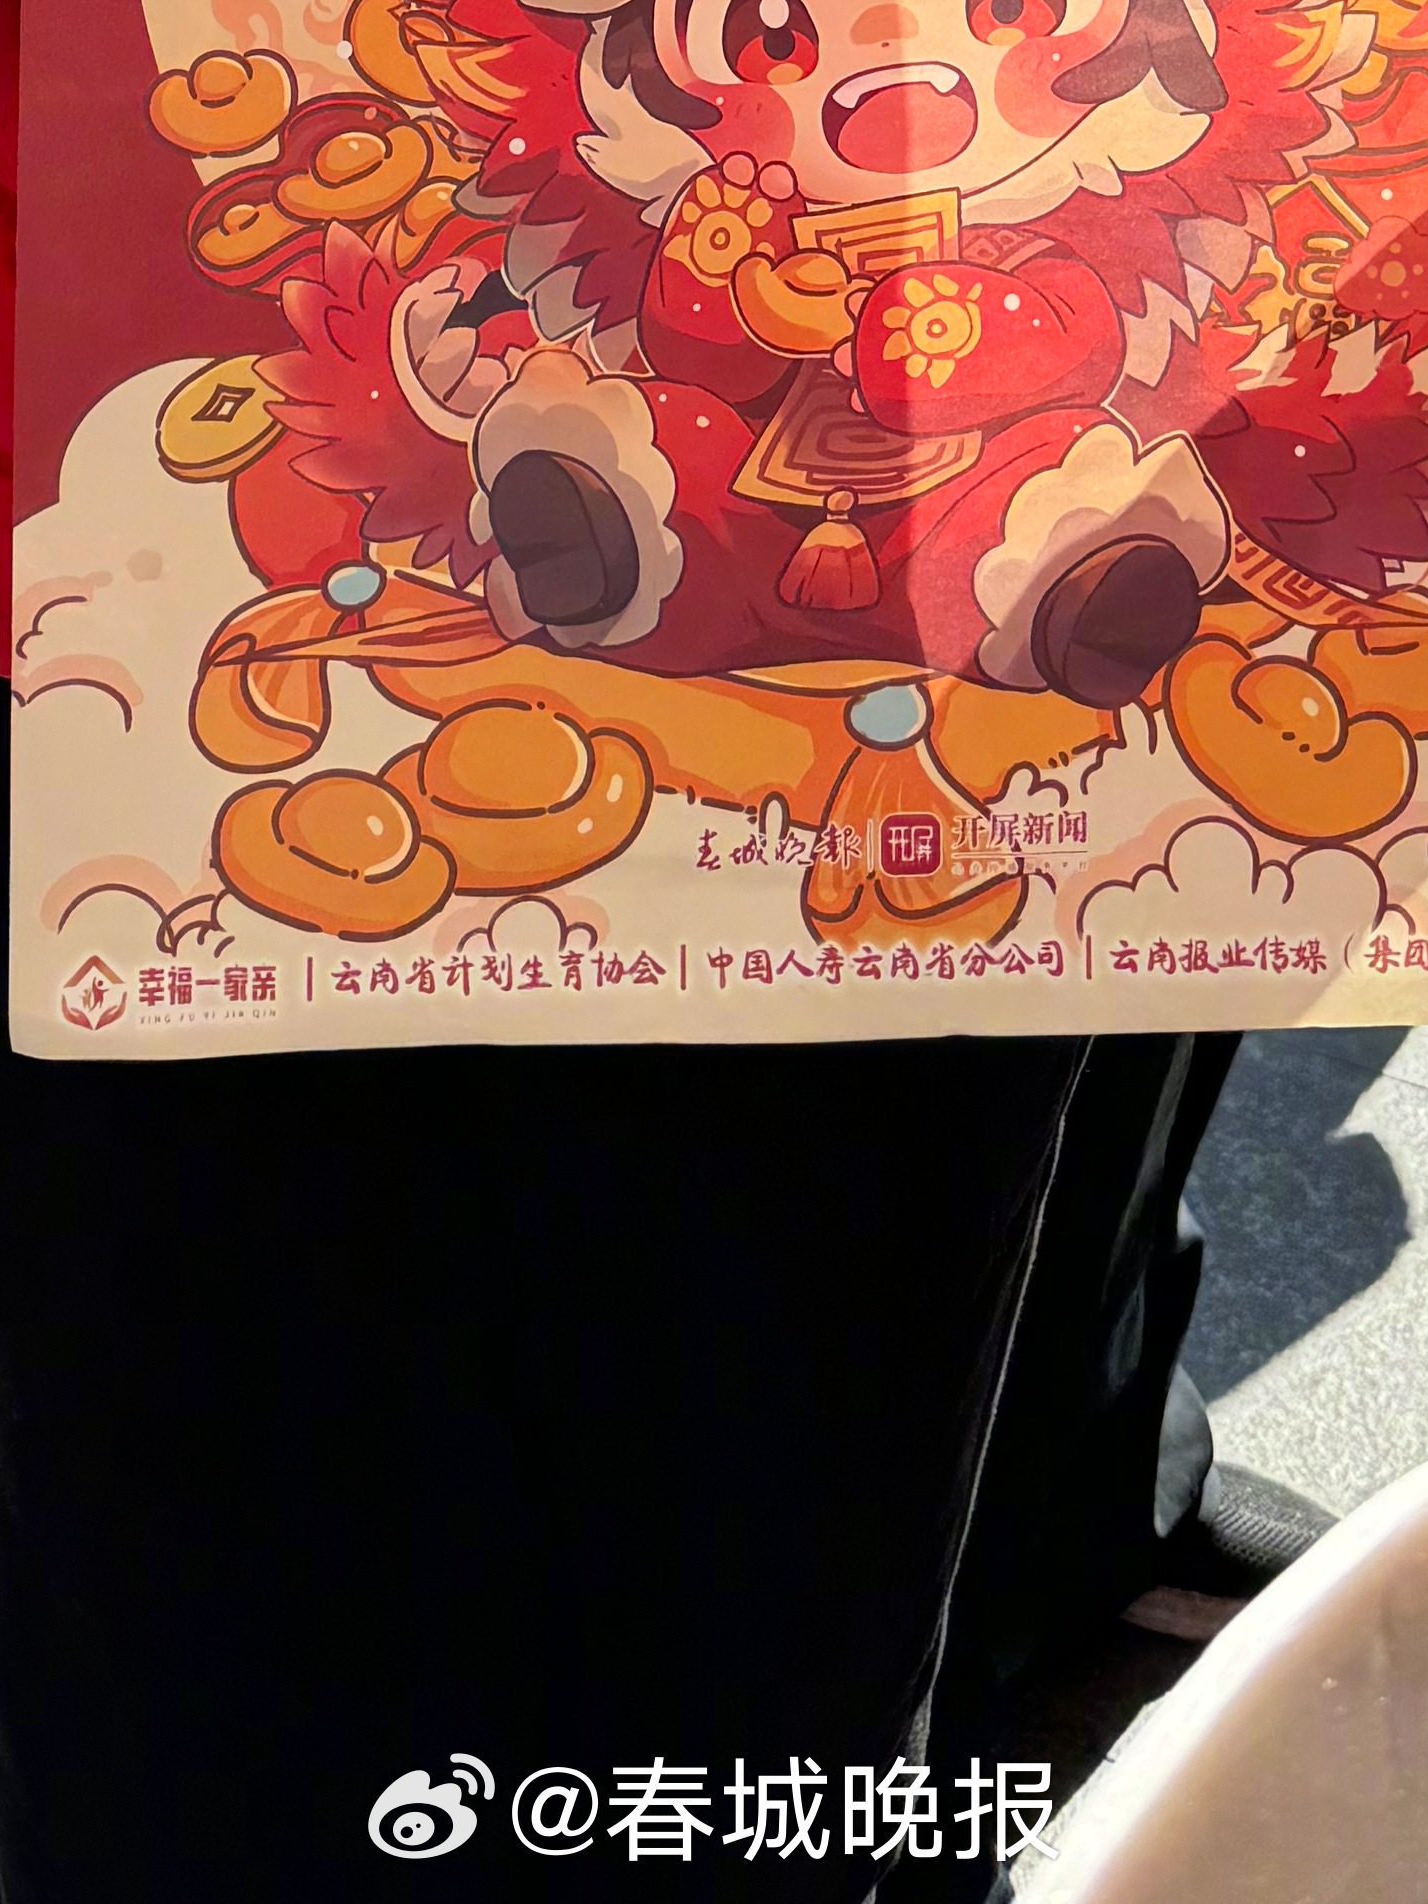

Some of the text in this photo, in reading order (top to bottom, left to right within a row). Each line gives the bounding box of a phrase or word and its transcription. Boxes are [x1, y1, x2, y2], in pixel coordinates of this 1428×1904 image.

[951, 809, 1089, 851] 开屏新闻
[138, 963, 277, 1007] 幸福一家亲
[331, 947, 668, 995] 云南省计划生育协会
[706, 938, 1065, 989] 中国人寿云南省分公司
